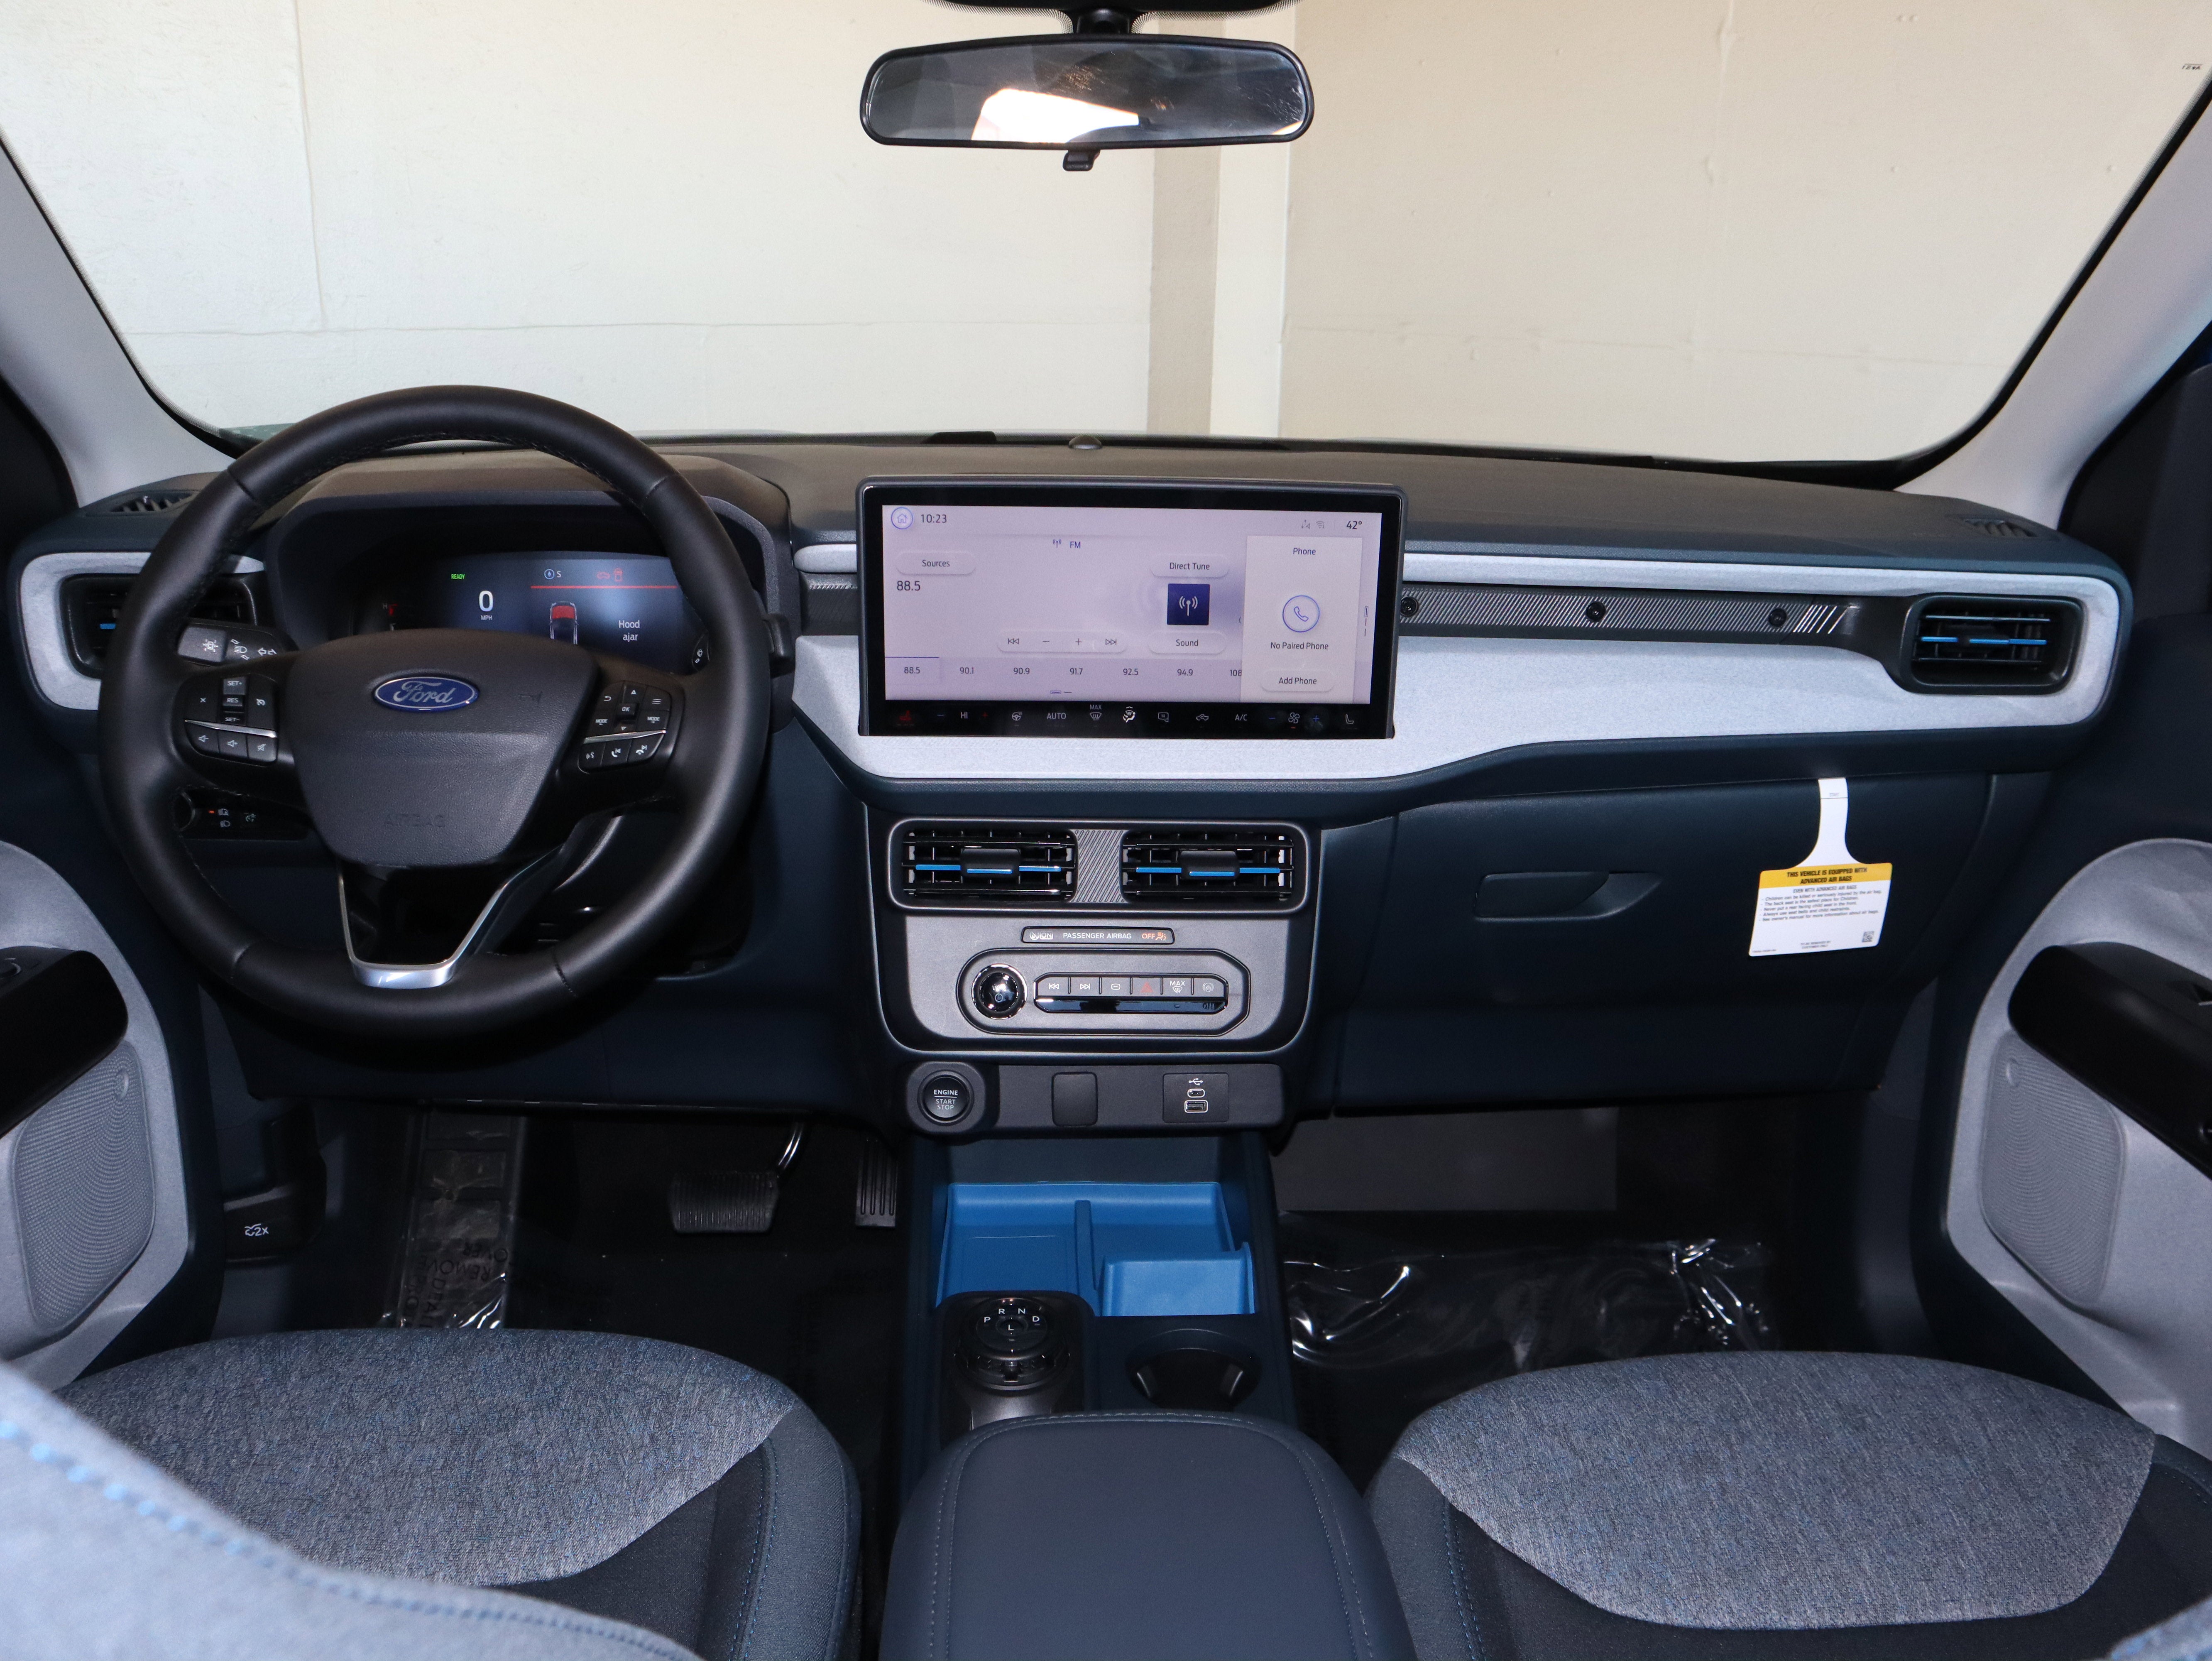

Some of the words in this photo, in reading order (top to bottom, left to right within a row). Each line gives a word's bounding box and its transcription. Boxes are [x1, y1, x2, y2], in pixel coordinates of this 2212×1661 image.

[921, 514, 947, 523] 10:23
[1346, 521, 1362, 529] 42°
[897, 581, 920, 591] 88.5
[479, 591, 493, 611] 0
[623, 632, 638, 642] ajar
[393, 681, 456, 703] Ford
